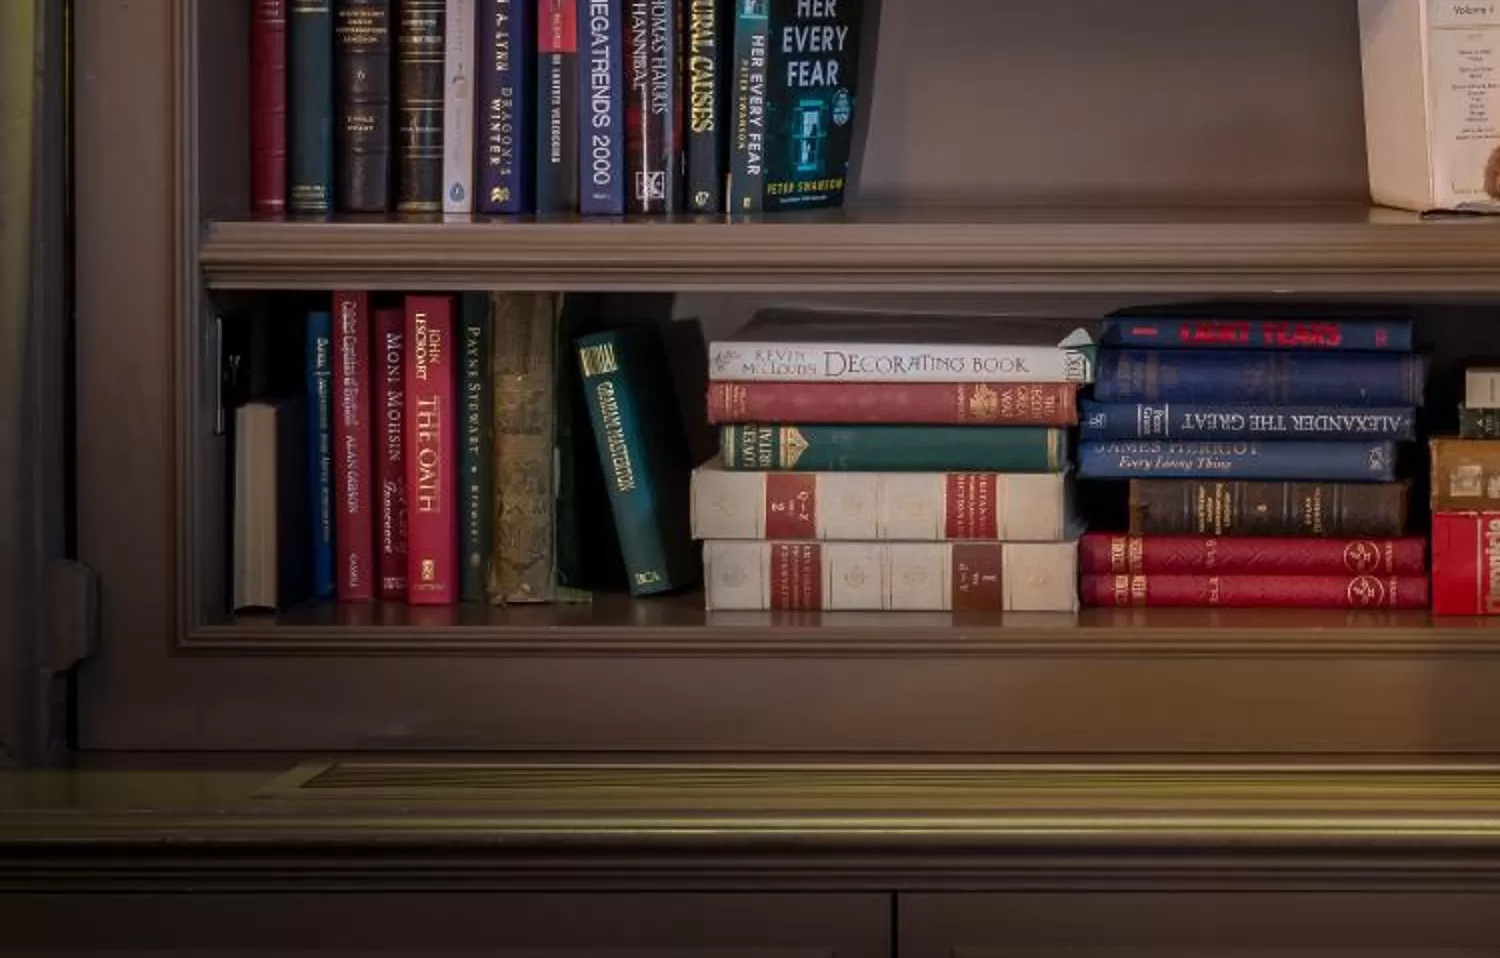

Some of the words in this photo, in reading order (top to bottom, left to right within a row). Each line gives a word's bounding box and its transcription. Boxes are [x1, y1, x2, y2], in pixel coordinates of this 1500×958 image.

[494, 32, 510, 73] LYNN
[631, 2, 648, 91] HANNIBAL
[750, 35, 765, 68] HER
[782, 25, 848, 53] EVERY
[691, 55, 715, 133] CAUSES
[787, 59, 839, 87] FEAR
[749, 72, 764, 128] EVERY
[488, 98, 502, 168] WINTER
[747, 133, 762, 176] FEAR
[591, 134, 611, 186] 2000
[387, 332, 402, 383] MONI
[429, 329, 441, 365] JOHN
[467, 325, 482, 377] PAYNE
[755, 349, 807, 362] KEVIN
[823, 351, 965, 377] DECORATING
[972, 357, 1029, 373] BOOK
[387, 391, 402, 462] MOHSIN
[417, 394, 439, 445] THE
[467, 381, 482, 456] STEWART
[1181, 413, 1246, 432] GREAT
[1249, 416, 1286, 432] THE
[1288, 415, 1402, 433] ALEXANDER
[346, 435, 359, 468] ALAN
[417, 448, 439, 513] OATH
